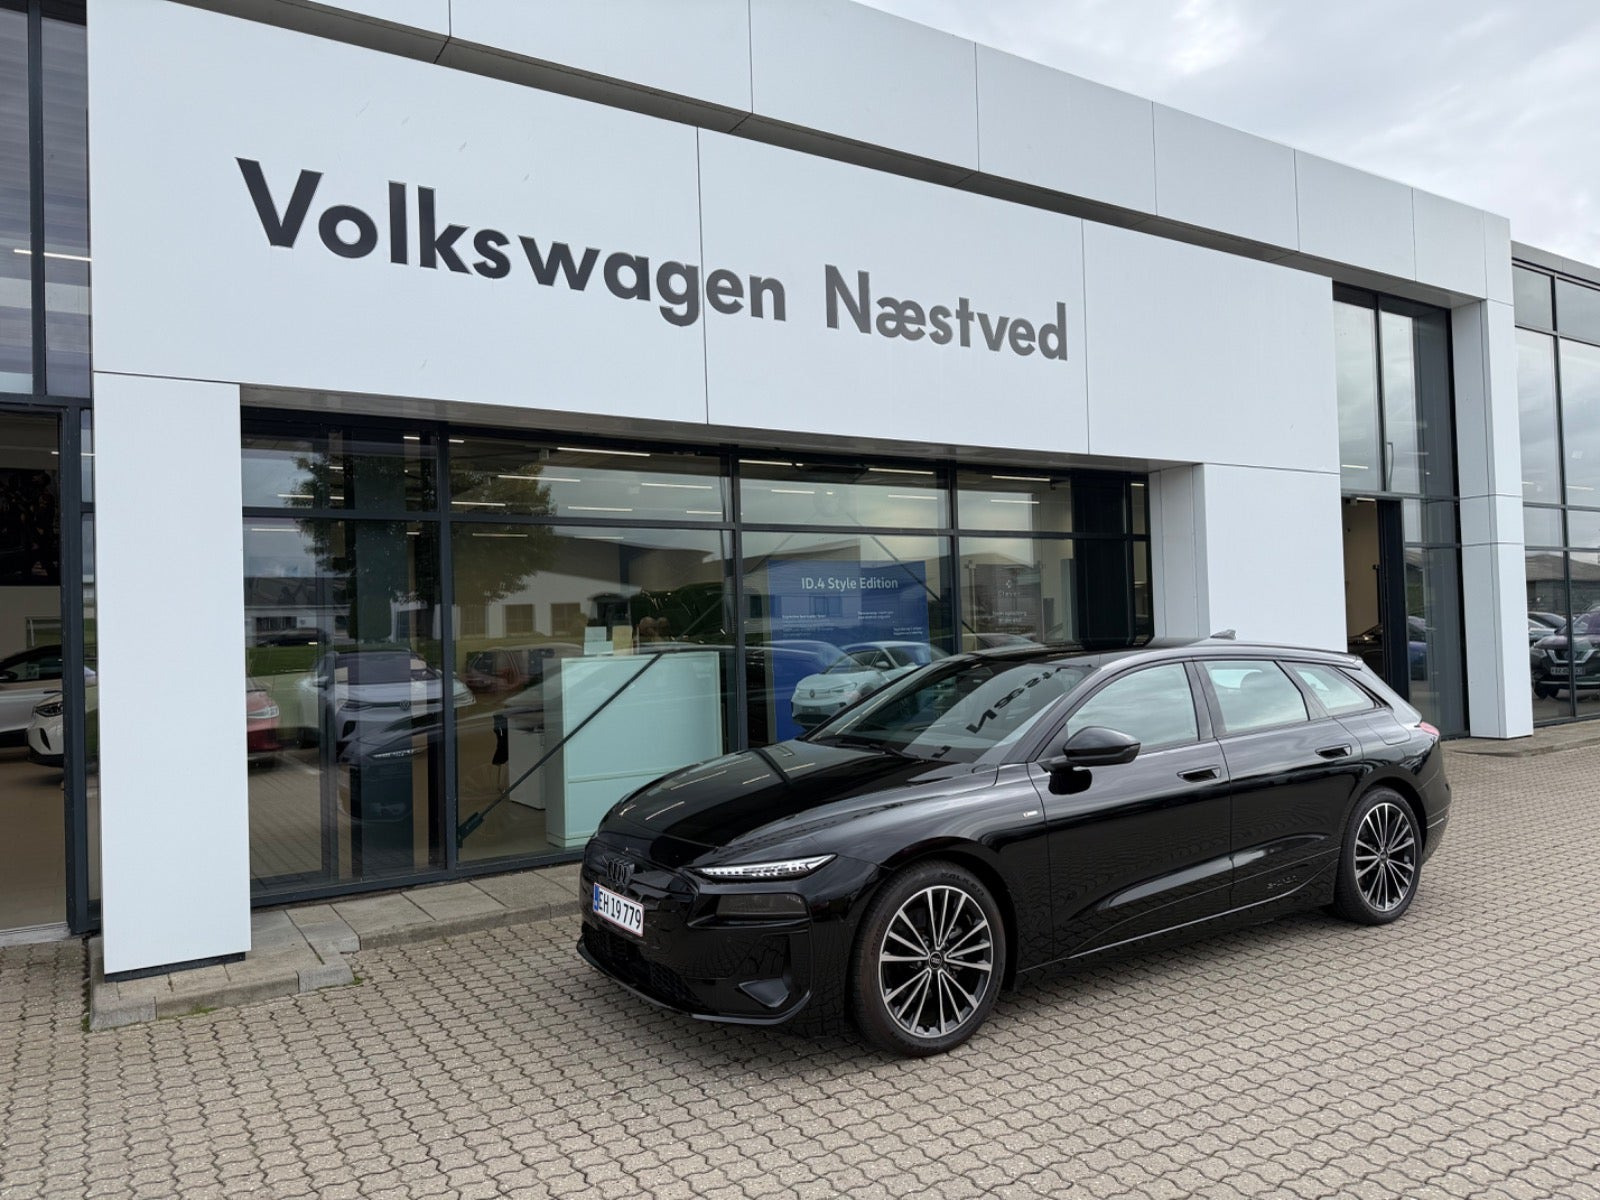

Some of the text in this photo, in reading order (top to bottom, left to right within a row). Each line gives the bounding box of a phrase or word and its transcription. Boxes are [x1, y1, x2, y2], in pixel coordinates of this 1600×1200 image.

[235, 157, 1067, 361] Volkswagen Næstved
[801, 577, 898, 592] ID.4 Style Edition
[599, 890, 642, 930] EH 19 779
